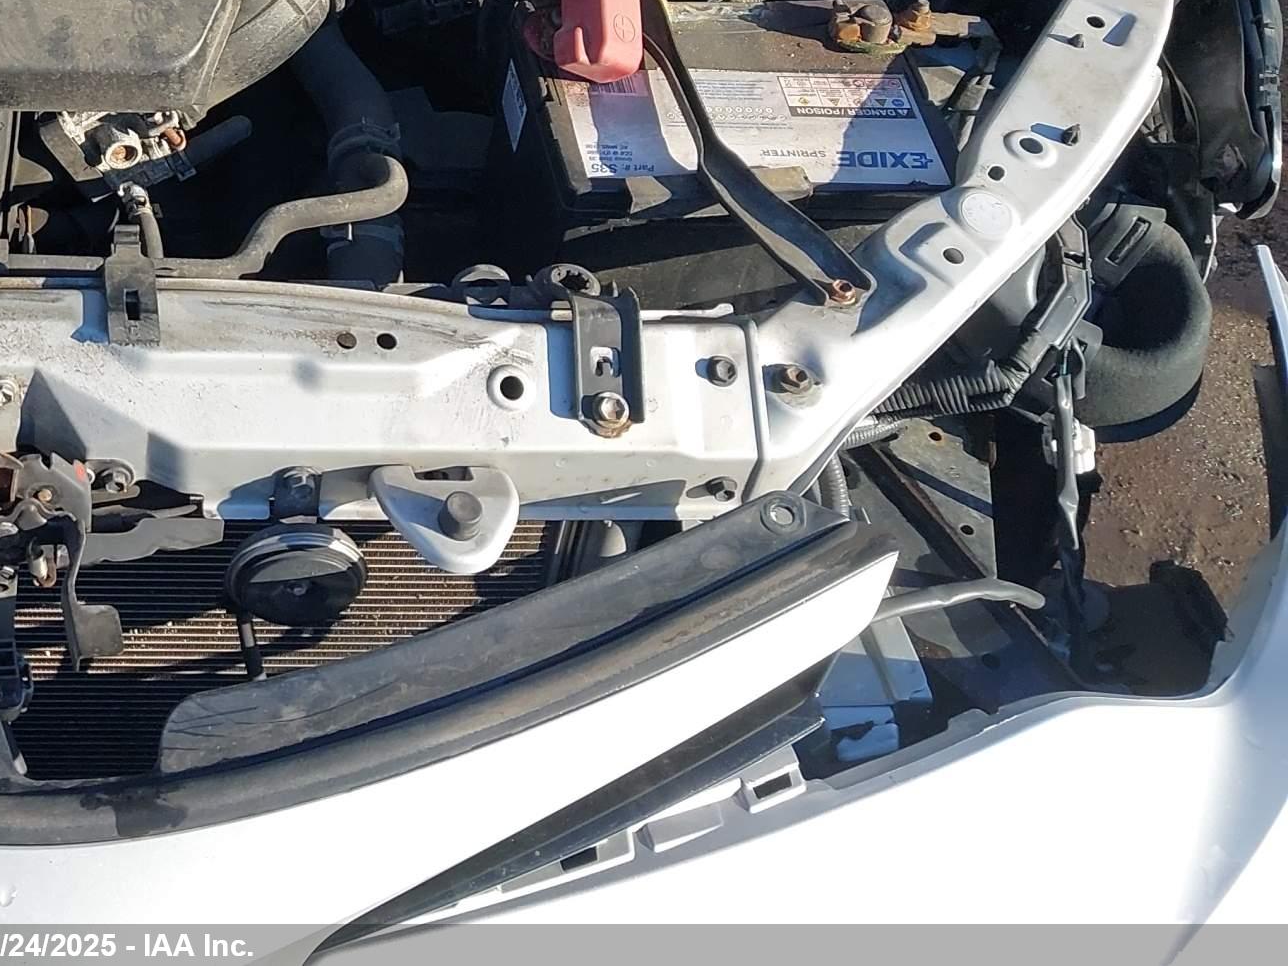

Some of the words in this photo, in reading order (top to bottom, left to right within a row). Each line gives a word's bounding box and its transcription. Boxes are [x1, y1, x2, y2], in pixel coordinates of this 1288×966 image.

[761, 148, 827, 159] SPRINTER
[833, 150, 934, 169] EXIDE
[592, 163, 618, 174] S35
[634, 163, 655, 173] Part
